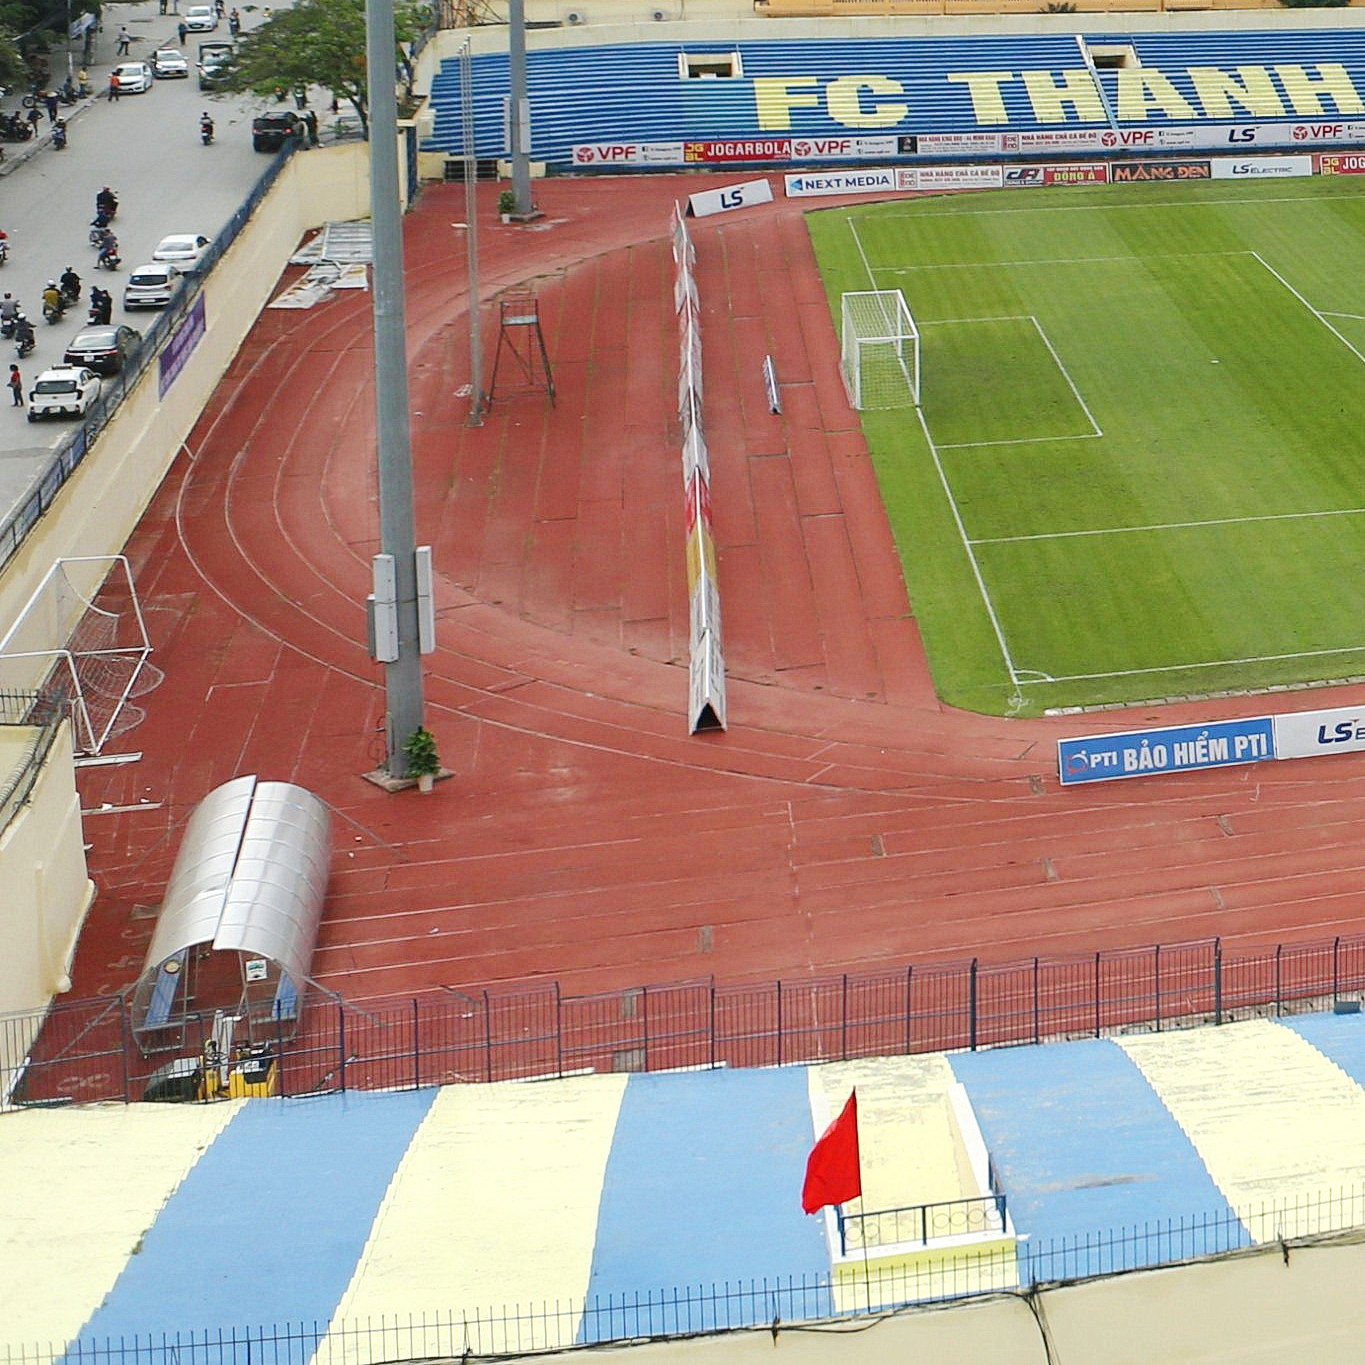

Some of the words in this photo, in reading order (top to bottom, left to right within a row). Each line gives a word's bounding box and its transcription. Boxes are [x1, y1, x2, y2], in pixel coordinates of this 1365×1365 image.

[753, 75, 909, 132] FC
[1120, 131, 1154, 145] VPF
[1228, 128, 1255, 143] LS
[1310, 125, 1343, 138] VPF
[597, 146, 636, 160] VPF
[706, 141, 791, 157] JOGARBOLA
[814, 139, 851, 154] VPF
[1233, 164, 1250, 174] LS
[805, 178, 841, 190] NEXT
[845, 175, 890, 187] MEDIA
[720, 190, 743, 209] LS
[1318, 722, 1352, 744] LS
[1090, 751, 1118, 769] PTI
[1123, 739, 1168, 772] BẢO
[1174, 731, 1229, 766] HIỂM
[1234, 733, 1268, 759] PTI
